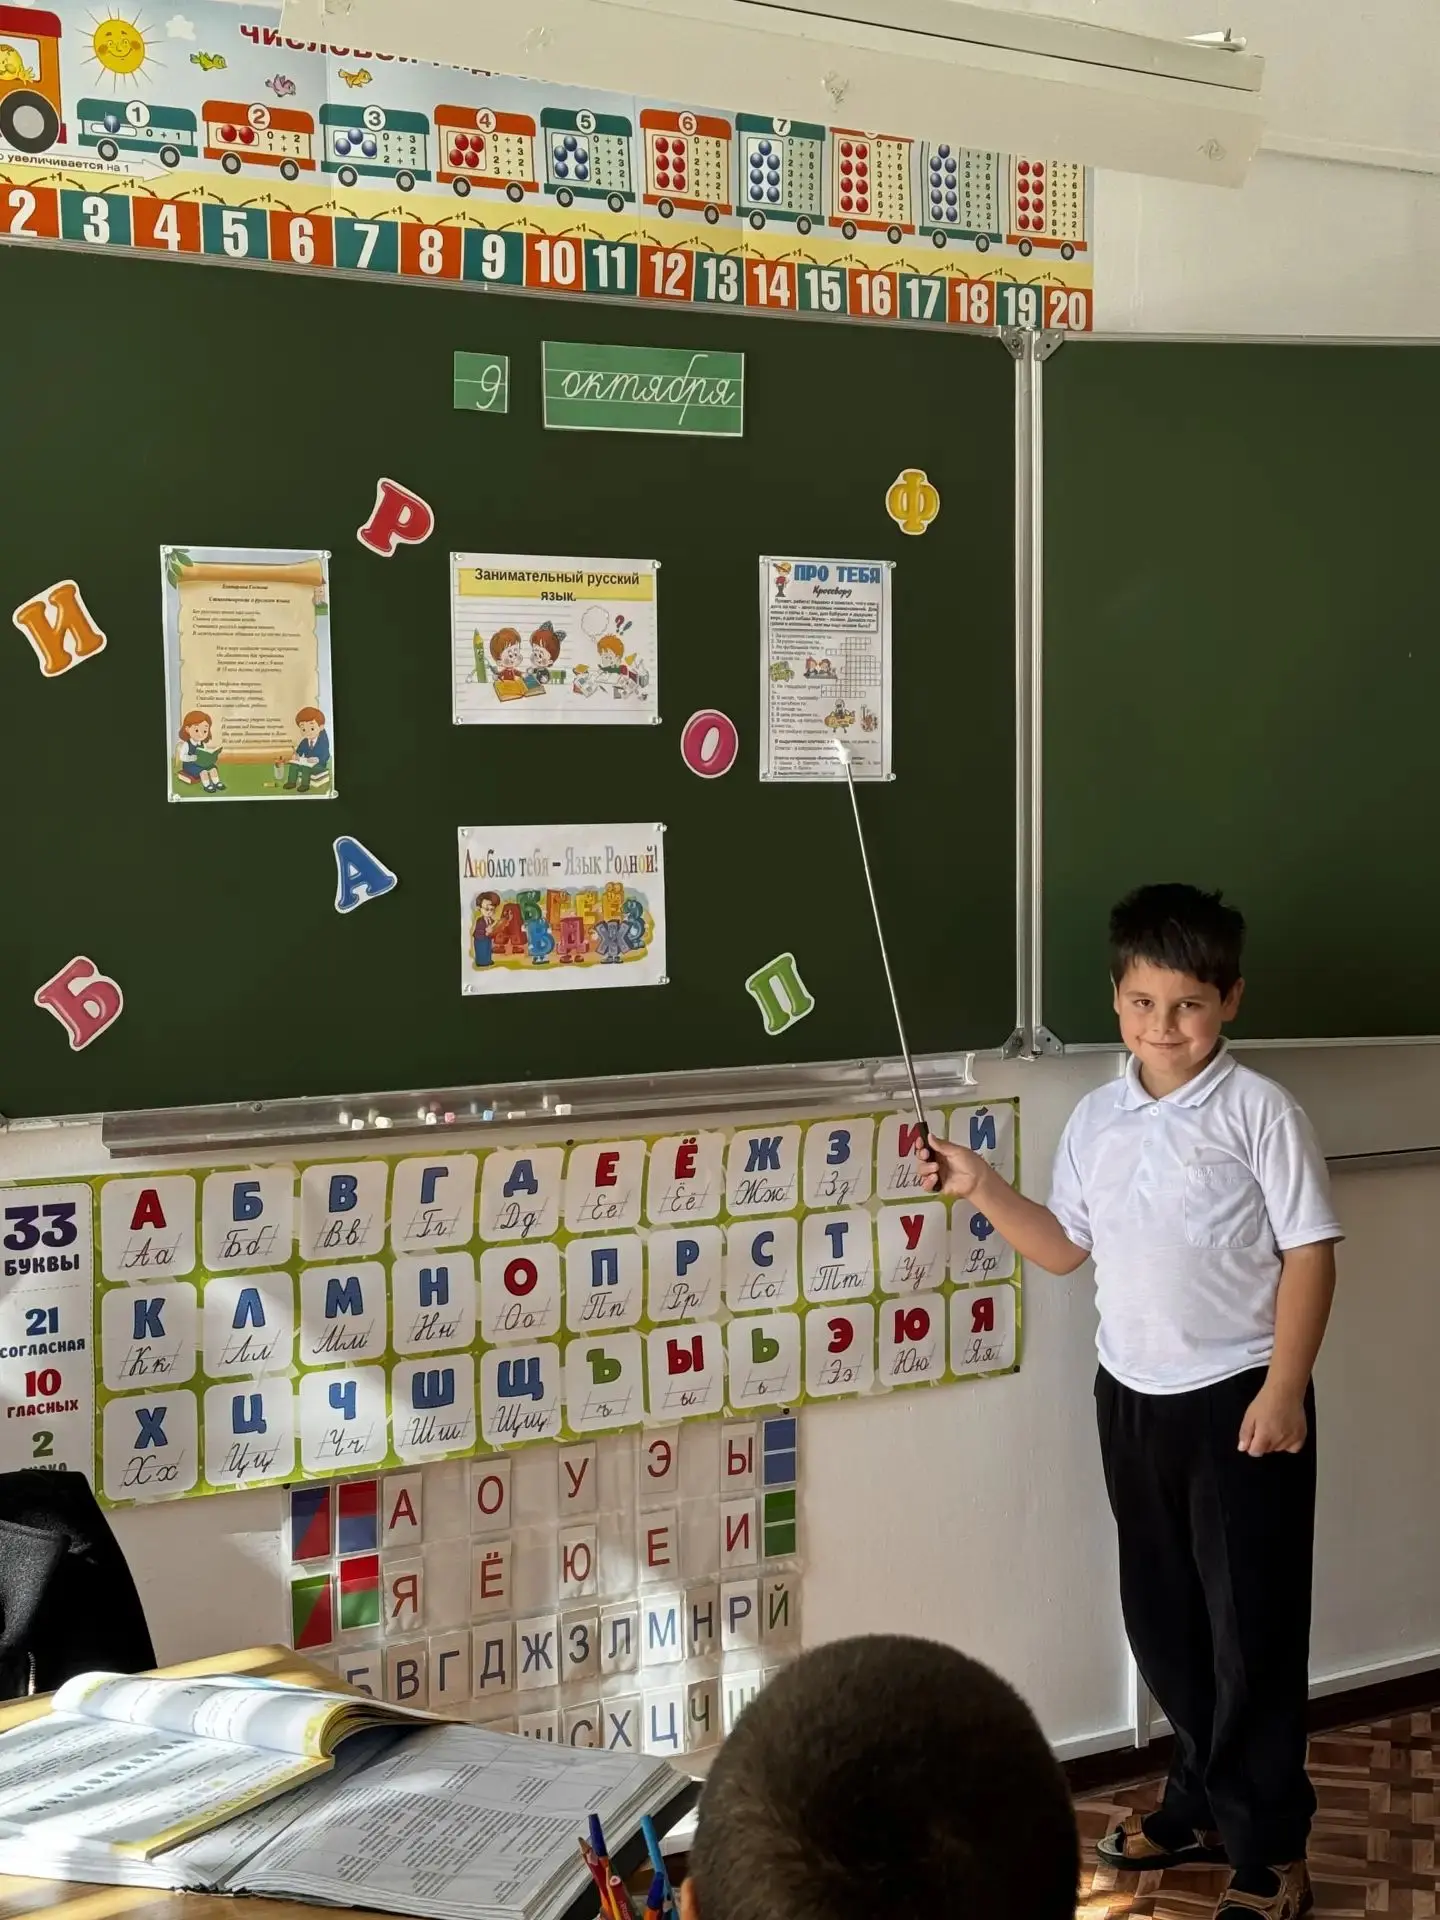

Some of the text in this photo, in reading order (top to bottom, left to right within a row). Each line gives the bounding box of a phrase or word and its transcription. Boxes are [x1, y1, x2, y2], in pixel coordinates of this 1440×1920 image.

[132, 107, 788, 132] 1 2 3 4 5 6 7
[7, 155, 104, 171] увеличивается
[107, 163, 120, 172] на
[50, 172, 528, 226] +1 +1 +1 +1 +1 +1 +1 +1
[7, 190, 1086, 330] 2 3 4 5 6 7 8 9 10 11 12 13 14 15 16 17 18 19 20
[476, 354, 736, 425] 9 октября
[360, 481, 432, 553] Р
[888, 471, 939, 533] Ф
[475, 568, 640, 587] Занимательный русский
[541, 590, 577, 601] язык.
[794, 564, 881, 583] ПРО ТЕБЯ
[17, 584, 105, 675] И
[683, 711, 737, 777] О
[336, 838, 396, 910] А
[464, 849, 515, 878] Люблю
[518, 849, 549, 877] тебя
[564, 847, 602, 876] Язык
[605, 845, 659, 878] Родной!
[37, 958, 121, 1048] Б
[748, 956, 812, 1032] П
[130, 1190, 166, 1230] А
[233, 1181, 263, 1221] Б
[329, 1175, 357, 1213] В
[421, 1167, 449, 1204] Г
[503, 1160, 538, 1197] Д
[595, 1152, 619, 1187] Е
[675, 1137, 698, 1181] Ё
[744, 1136, 783, 1172] Ж
[827, 1130, 850, 1164] З
[967, 1106, 996, 1153] Й
[4, 1202, 77, 1250] 33
[5, 1254, 79, 1276] БУКВЫ
[133, 1298, 165, 1339] К
[232, 1288, 265, 1329] Л
[325, 1277, 363, 1318] М
[420, 1267, 448, 1307] Н
[504, 1258, 537, 1296] О
[591, 1248, 618, 1287] П
[677, 1240, 699, 1276] Р
[752, 1231, 774, 1267] С
[825, 1222, 848, 1258] Т
[900, 1215, 924, 1250] У
[0, 1338, 85, 1358] СОГЛАСНАЯ
[25, 1307, 58, 1336] 21
[26, 1369, 61, 1397] 10
[134, 1297, 993, 1449] Х Ц Ч Ш Щ Ъ Ы Ь Э Ю Я
[8, 1400, 78, 1418] ГЛАСНЫХ
[33, 1431, 53, 1458] 2
[389, 1437, 752, 1529] А О У Э Ы
[392, 1513, 749, 1617] Я Ё Ю Е И
[397, 1660, 419, 1700] В
[440, 1650, 459, 1691] Г
[480, 1640, 505, 1688] Д
[522, 1632, 552, 1673] Ж
[570, 1625, 590, 1664] З
[608, 1618, 630, 1658] Л
[649, 1609, 675, 1648] М
[694, 1604, 712, 1641] Н
[730, 1596, 751, 1633] Р
[770, 1584, 788, 1628] Й
[609, 1710, 632, 1750] Х
[652, 1703, 677, 1748] Ц
[692, 1694, 710, 1732] Ч
